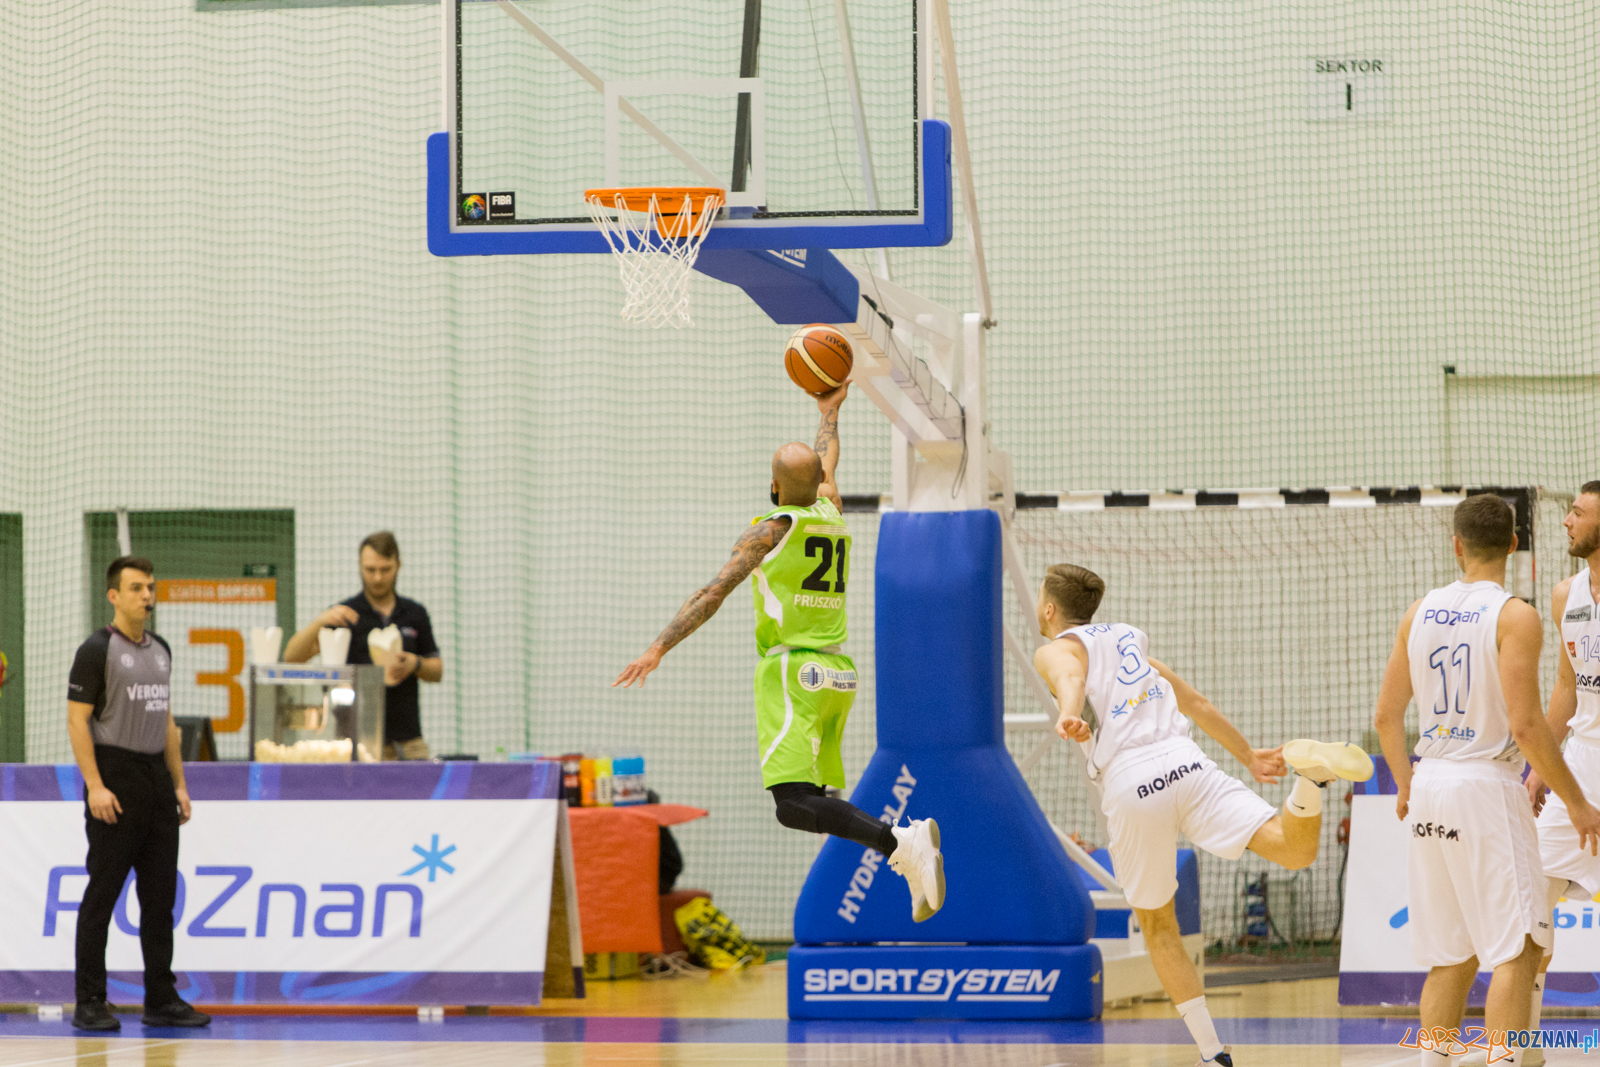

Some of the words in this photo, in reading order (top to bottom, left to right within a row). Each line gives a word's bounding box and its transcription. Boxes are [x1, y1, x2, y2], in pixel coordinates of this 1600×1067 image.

[1316, 59, 1383, 73] SEKTOR
[492, 195, 512, 206] FIBA
[825, 335, 852, 358] molte
[801, 536, 845, 593] 21
[794, 594, 843, 609] PRUSZKÓ
[1116, 631, 1151, 685] 5
[189, 628, 244, 732] 3
[1429, 643, 1470, 715] 11
[837, 764, 917, 924] HYDRPLAY
[1553, 907, 1600, 929] bi
